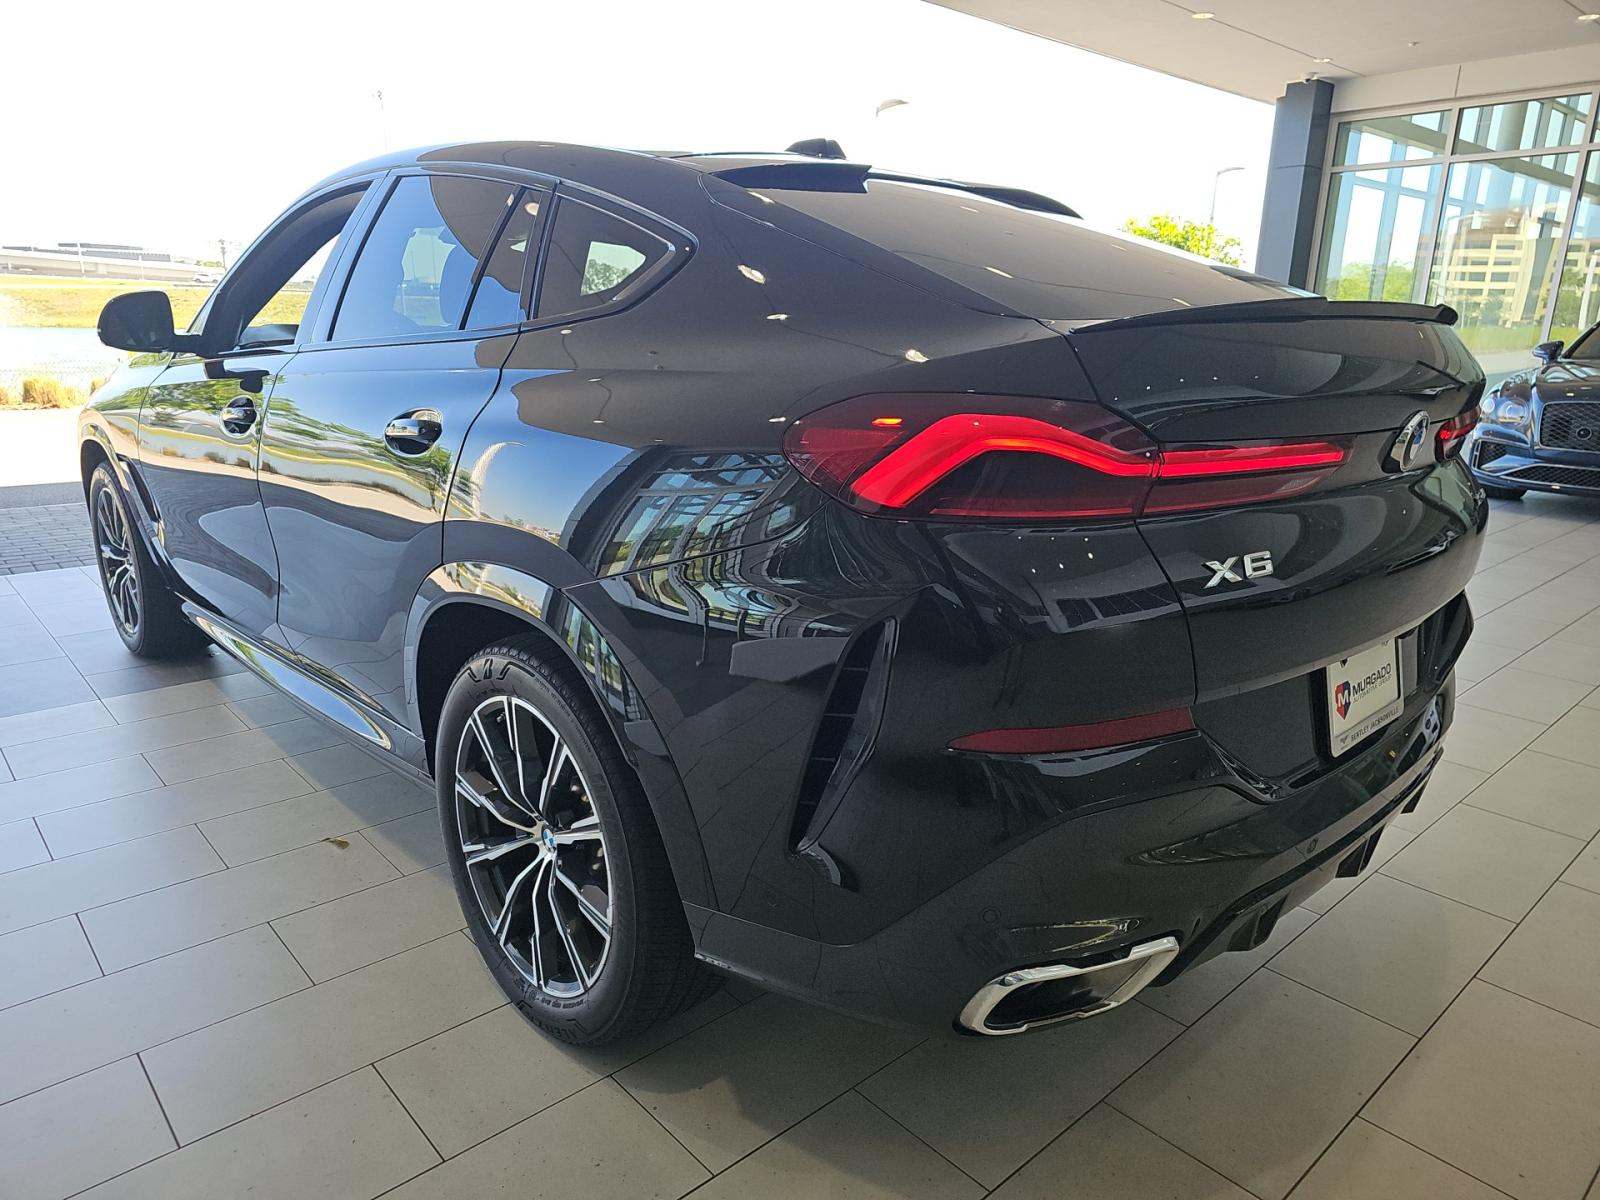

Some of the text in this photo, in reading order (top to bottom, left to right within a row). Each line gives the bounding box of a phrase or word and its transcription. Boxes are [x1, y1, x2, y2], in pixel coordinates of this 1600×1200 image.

[1202, 550, 1274, 589] X6
[1352, 663, 1391, 696] MURGADO
[1338, 690, 1349, 707] M
[1350, 726, 1369, 741] BENTLEY
